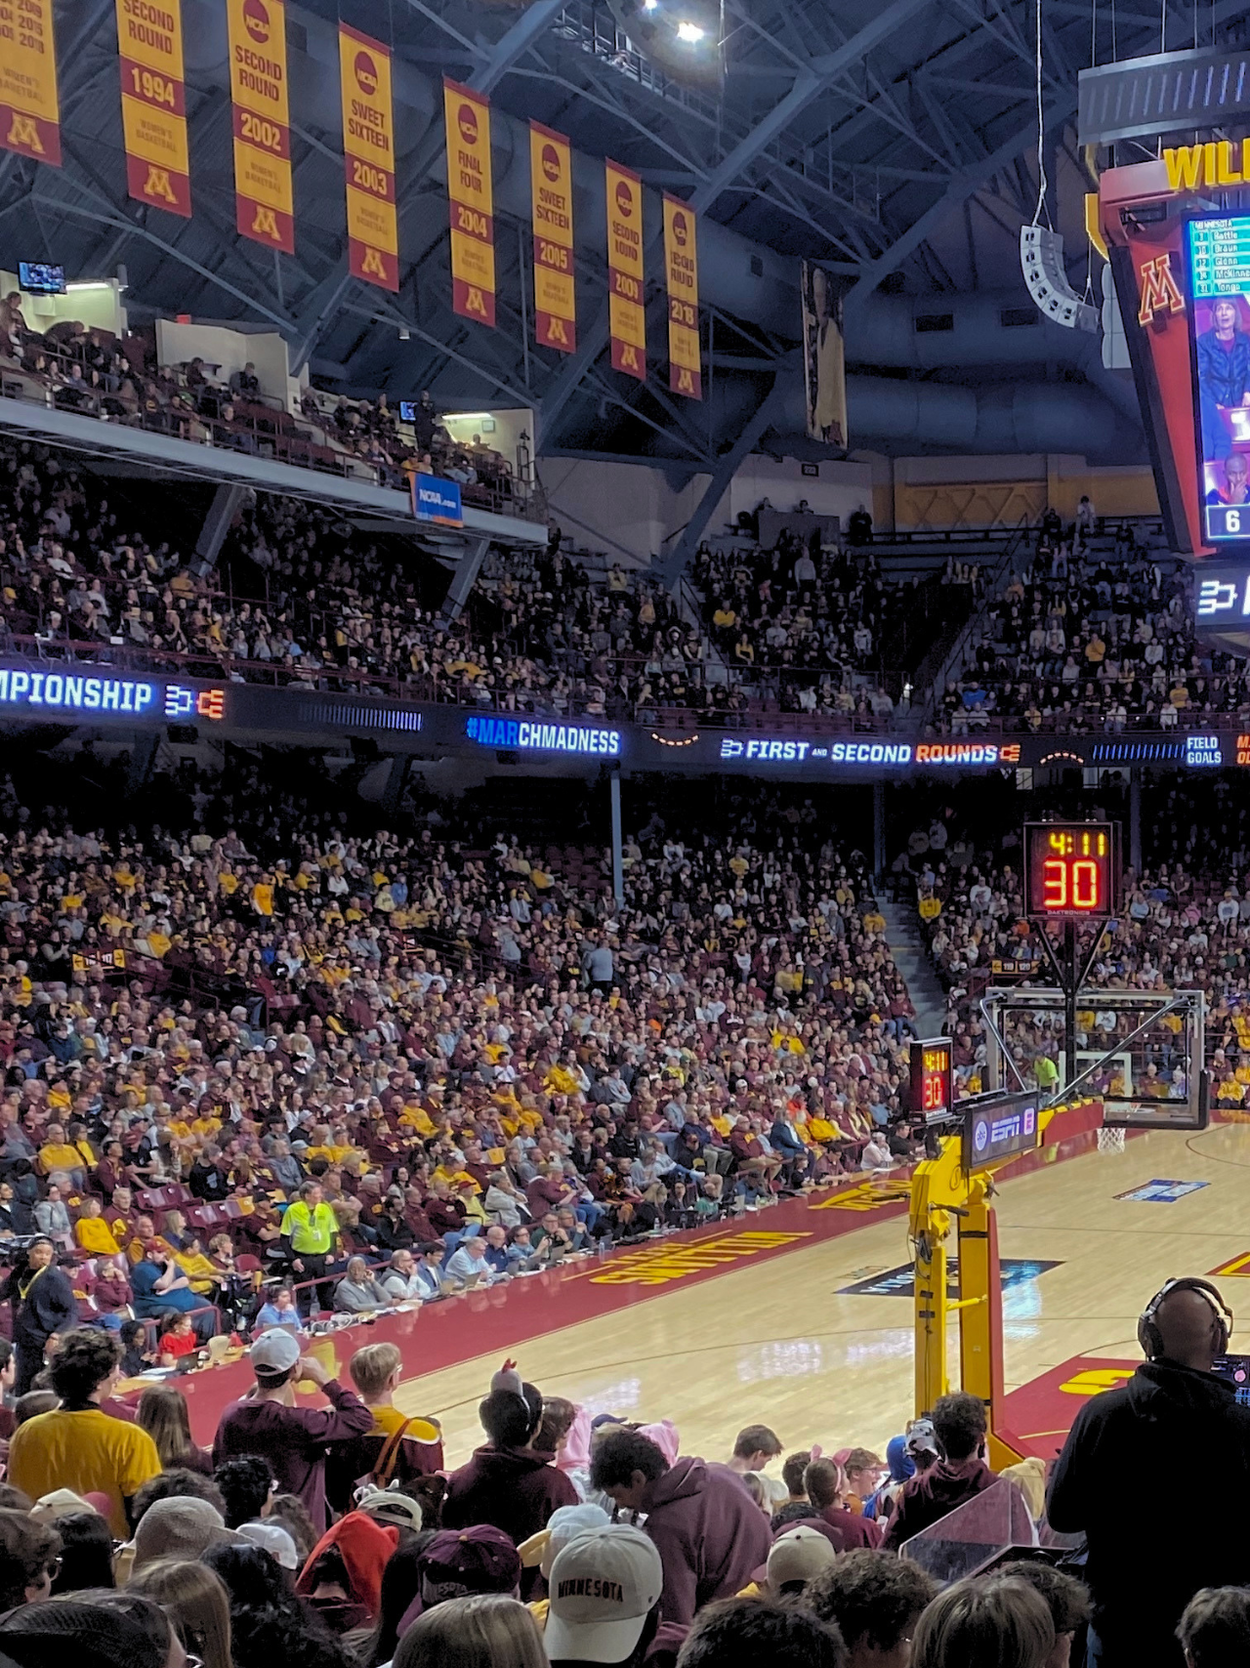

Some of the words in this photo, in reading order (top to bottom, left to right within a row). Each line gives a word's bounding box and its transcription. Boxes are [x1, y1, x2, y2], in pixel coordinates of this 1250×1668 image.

[123, 0, 174, 32] SECOND
[128, 18, 172, 55] ROUND
[235, 44, 282, 81] SECOND
[131, 66, 175, 107] 1994
[239, 68, 279, 102] ROUND
[351, 98, 385, 130] SWEET
[240, 112, 281, 151] 2002
[348, 117, 390, 152] SIXTEEN
[353, 160, 388, 196] 2003
[458, 150, 483, 177] FINAL
[460, 169, 483, 194] FOUR
[539, 186, 566, 211] SWEET
[458, 206, 488, 238] 2004
[536, 203, 570, 231] SIXTEEN
[540, 241, 568, 270] 2005
[1225, 510, 1240, 532] 6
[467, 716, 620, 754] #MARCHMADNESS
[746, 740, 809, 760] FIRST
[812, 748, 827, 757] AND
[831, 743, 911, 762] SECOND
[916, 743, 998, 762] ROUNDS
[1187, 736, 1218, 749] FIELD
[1188, 751, 1222, 764] GOALS
[1050, 832, 1105, 856] 4:11
[1044, 861, 1097, 907] 30
[925, 1051, 945, 1073] 4:11
[925, 1076, 942, 1108] 30
[558, 1577, 624, 1602] MINNESOTA
